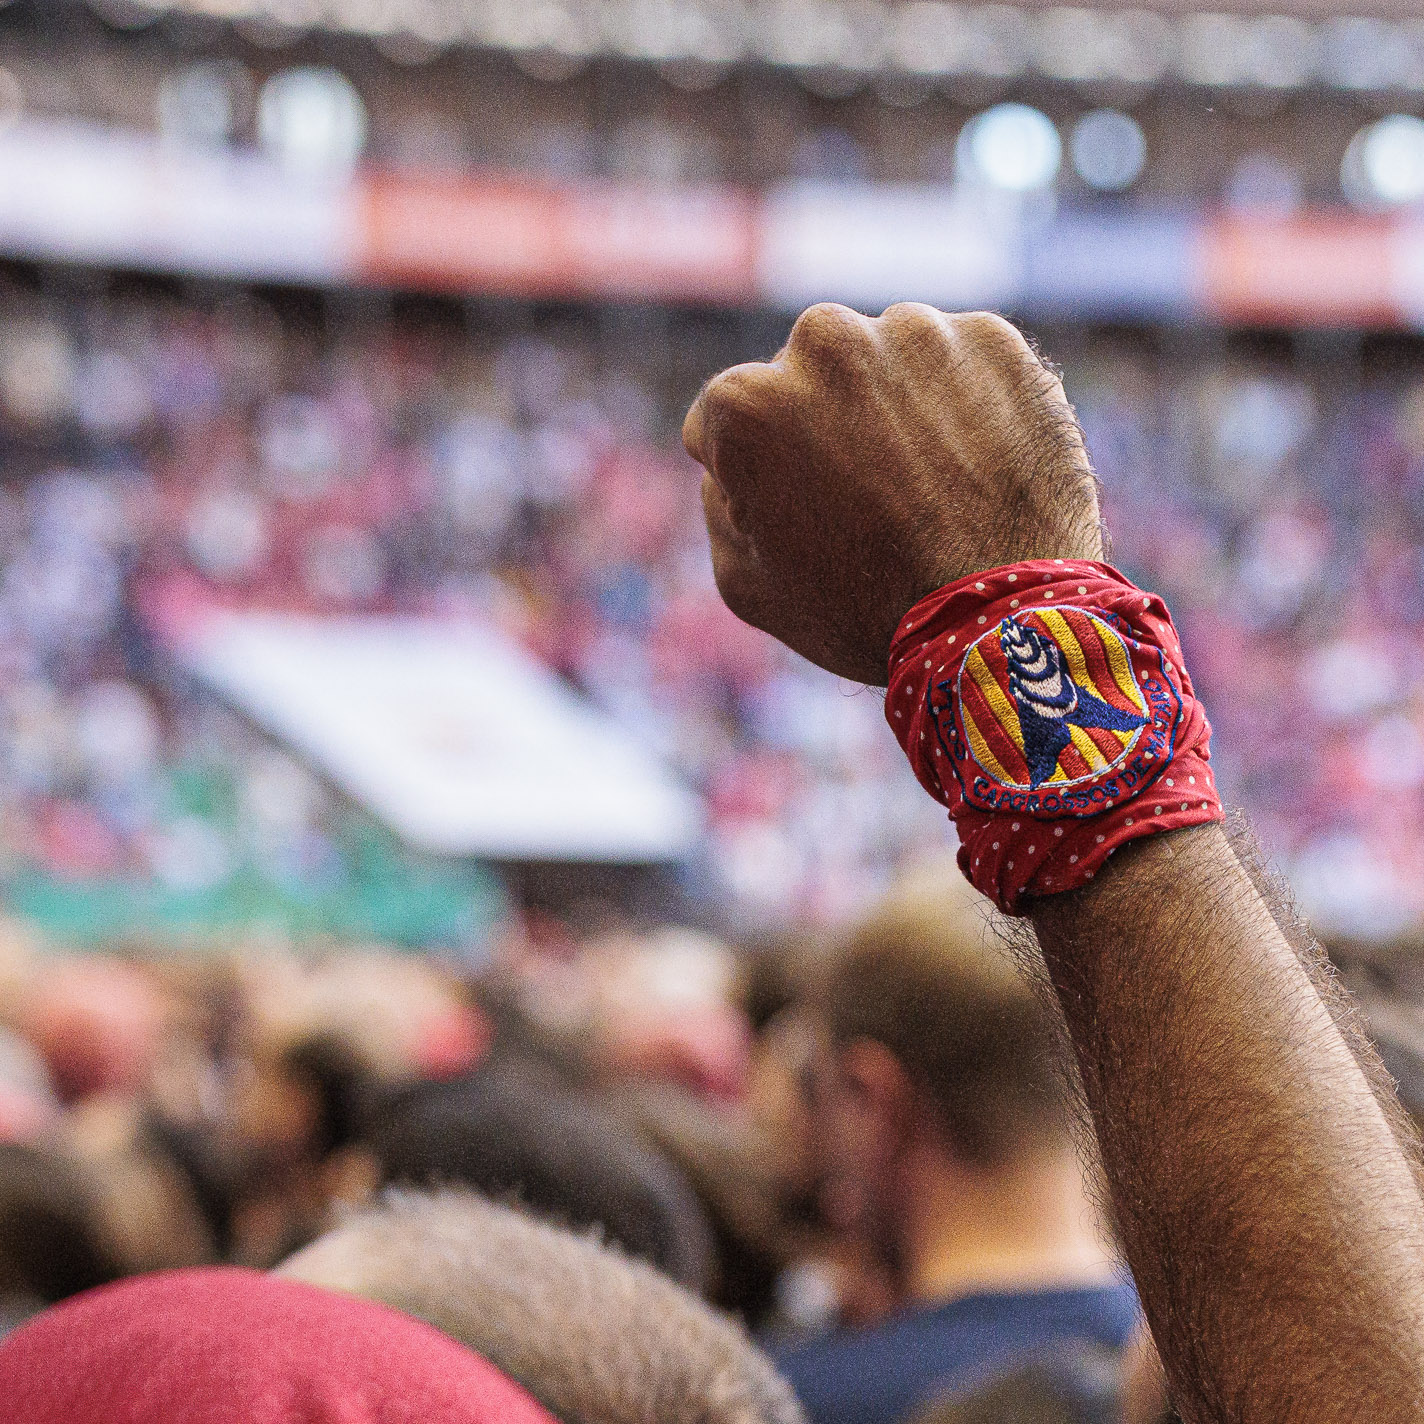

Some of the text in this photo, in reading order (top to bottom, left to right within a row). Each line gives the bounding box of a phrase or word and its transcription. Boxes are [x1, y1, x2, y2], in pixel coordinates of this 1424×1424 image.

[936, 677, 966, 761] COLLA
[973, 776, 1120, 812] CAPGROSSOS
[1119, 755, 1151, 788] DE
